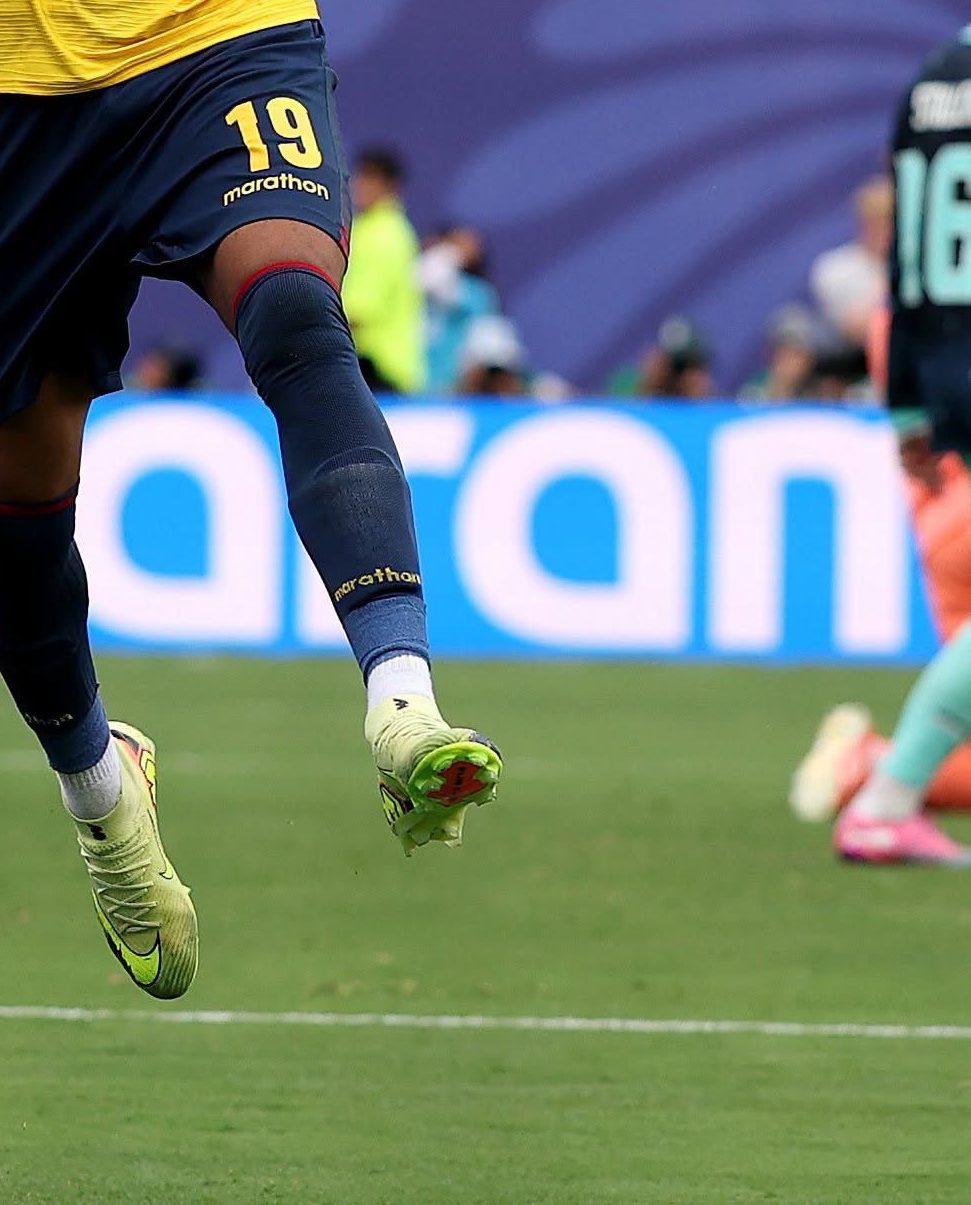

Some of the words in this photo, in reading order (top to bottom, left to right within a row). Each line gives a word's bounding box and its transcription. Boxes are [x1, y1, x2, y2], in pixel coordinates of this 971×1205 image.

[224, 96, 324, 173] 19
[222, 172, 330, 207] marathon
[893, 142, 971, 309] 16
[333, 566, 421, 602] marathon
